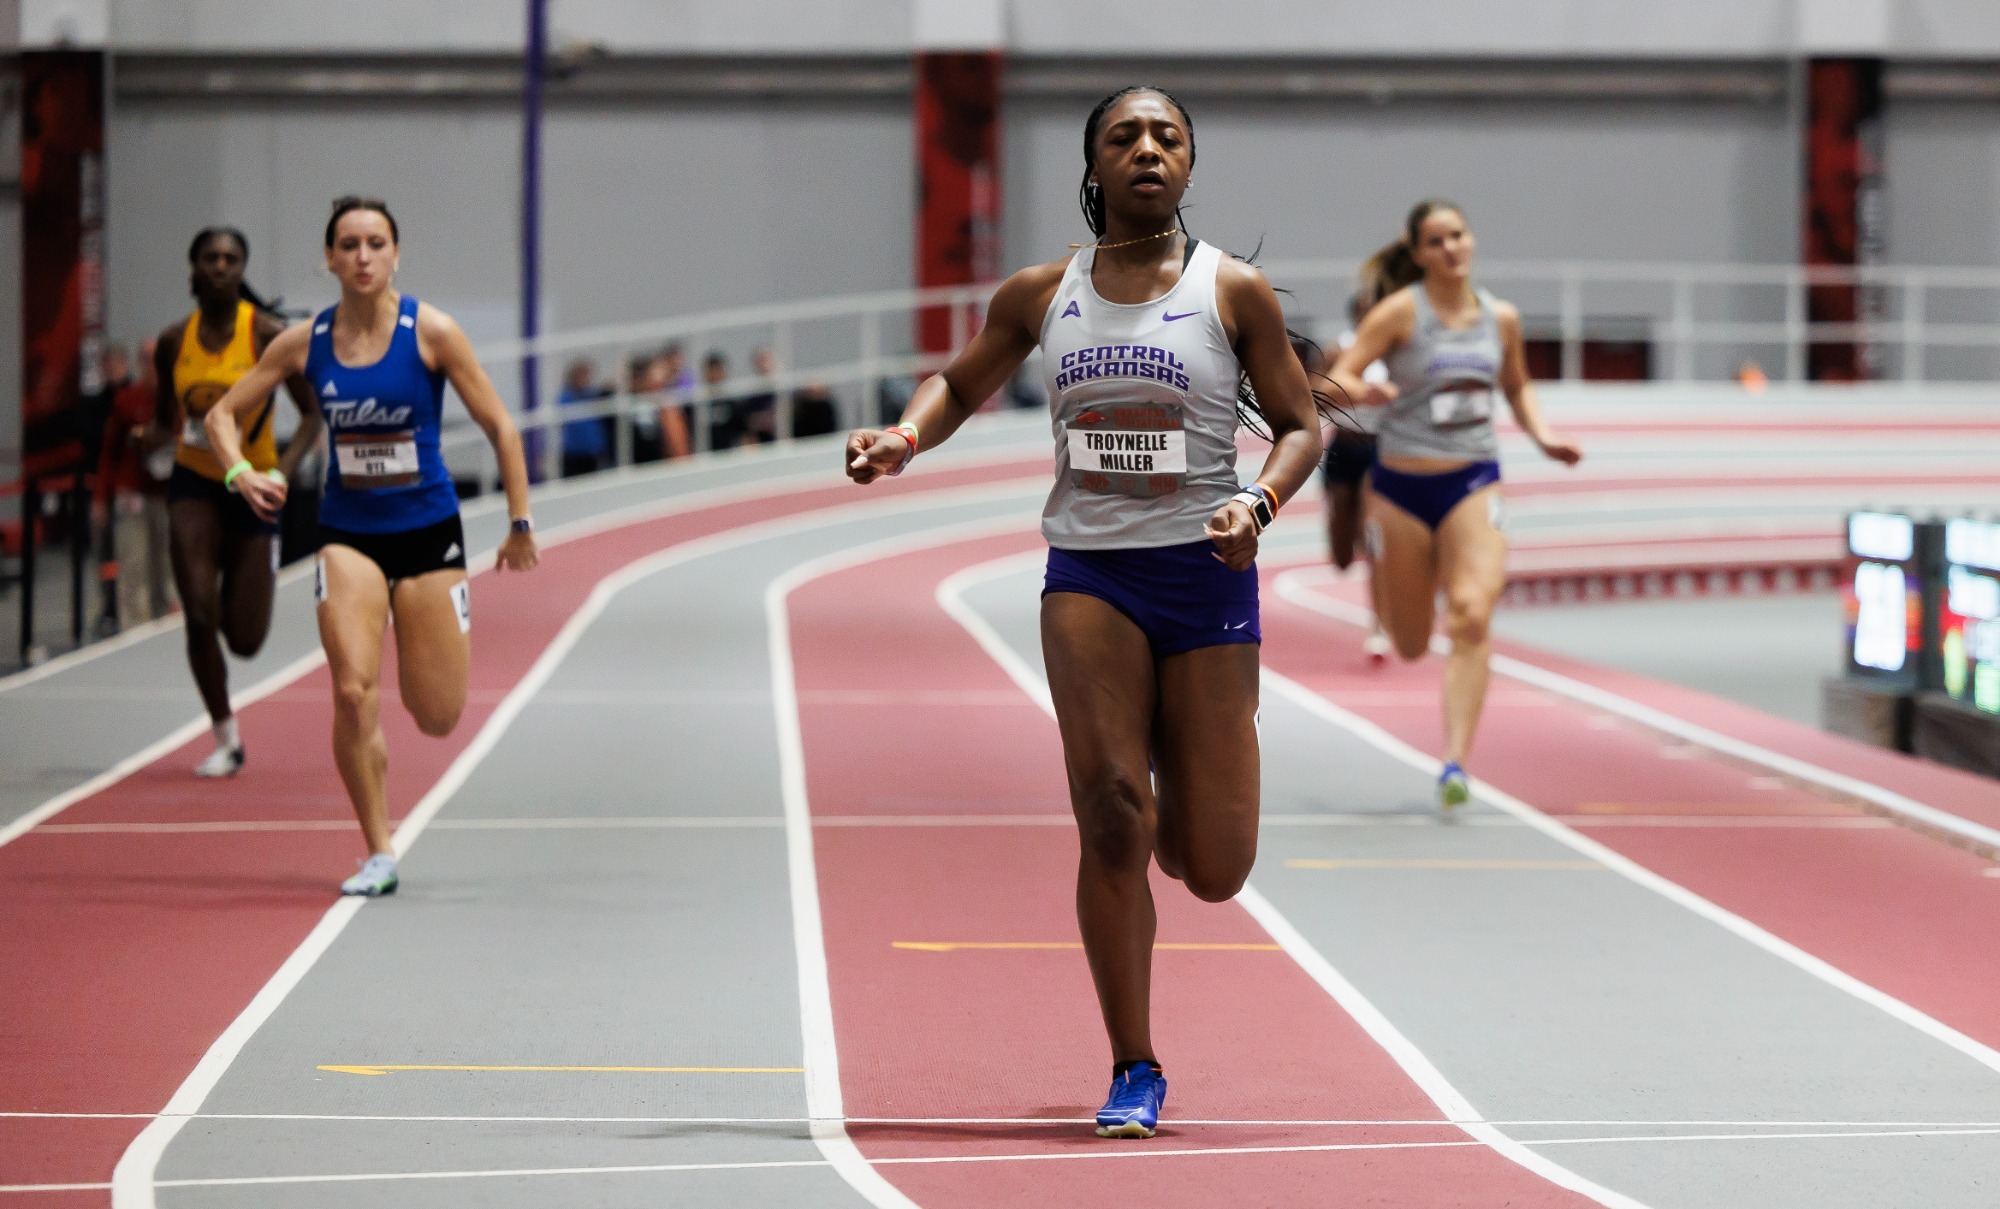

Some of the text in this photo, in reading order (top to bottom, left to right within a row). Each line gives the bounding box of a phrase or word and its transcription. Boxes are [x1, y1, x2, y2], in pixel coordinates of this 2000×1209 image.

[1061, 345, 1184, 371] CENTRAL
[1055, 361, 1190, 392] ARKANSAS
[323, 397, 412, 428] Tulsa
[1085, 432, 1168, 451] TROYNELLE
[1100, 454, 1154, 472] MILLER
